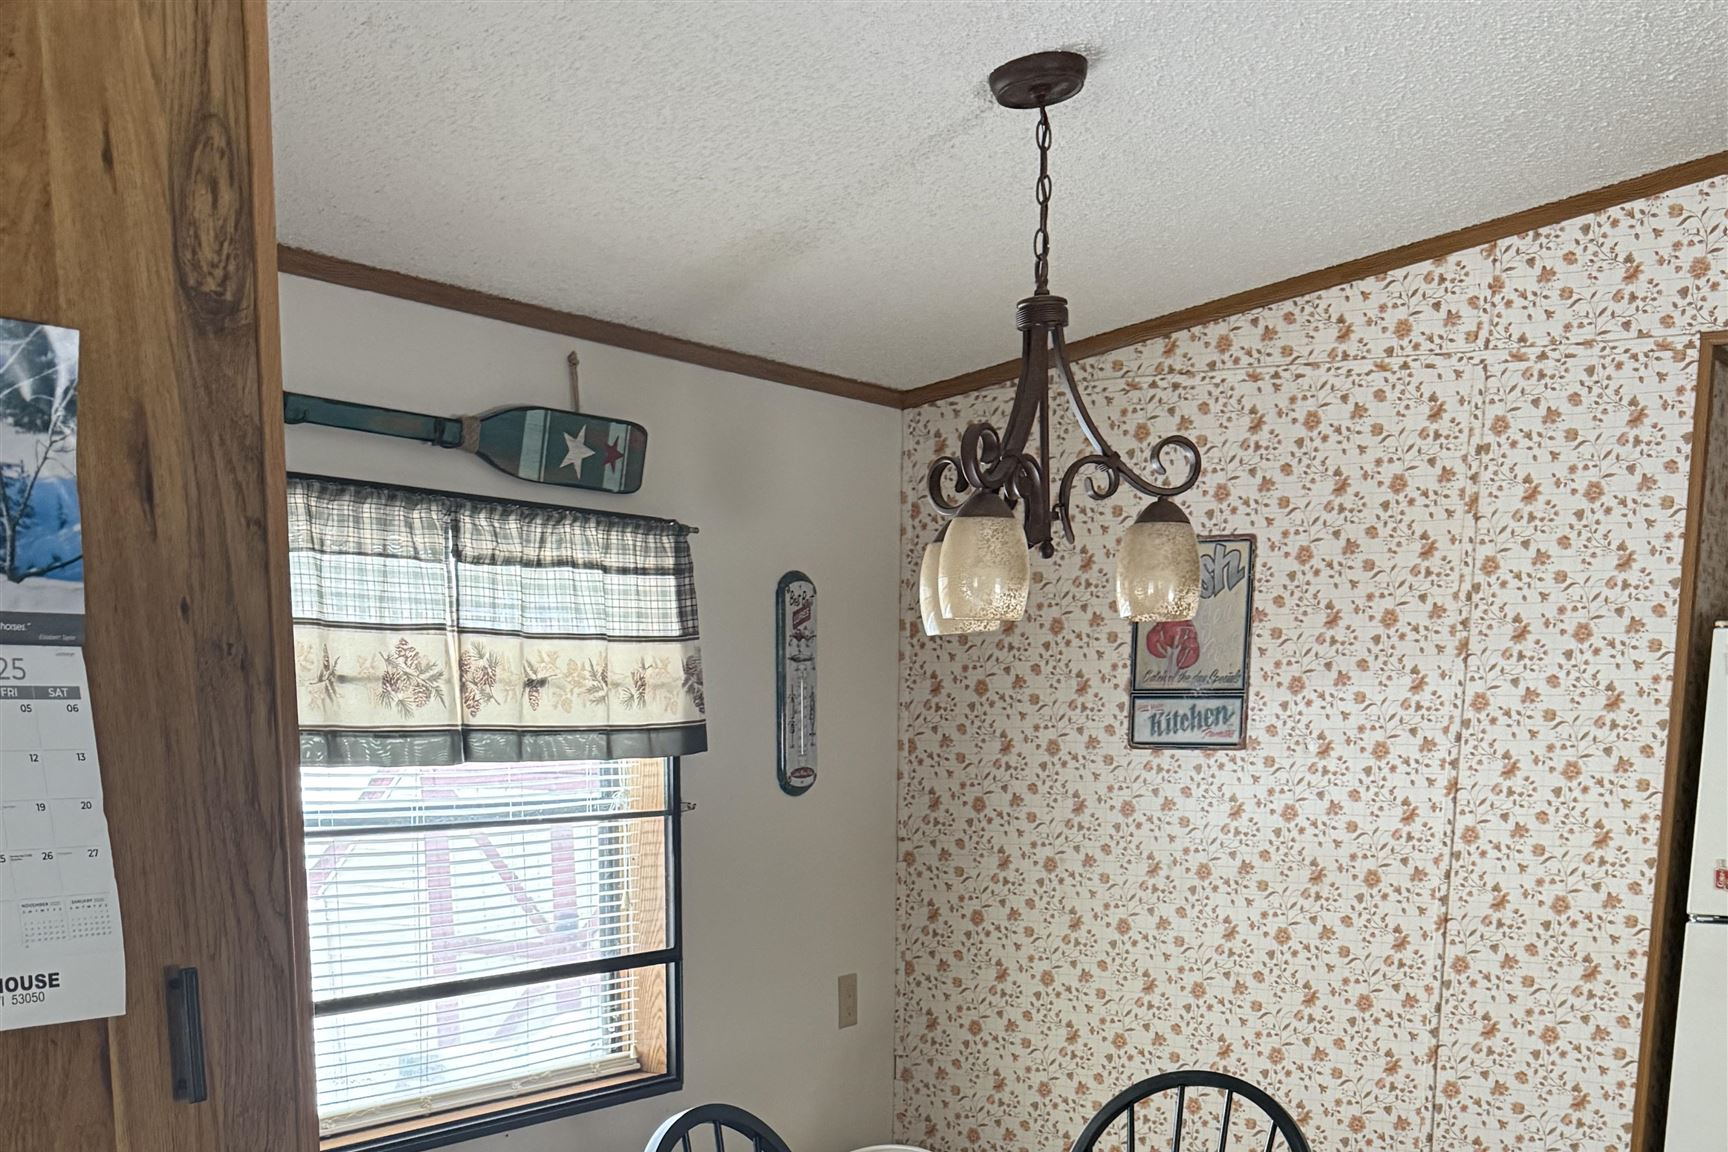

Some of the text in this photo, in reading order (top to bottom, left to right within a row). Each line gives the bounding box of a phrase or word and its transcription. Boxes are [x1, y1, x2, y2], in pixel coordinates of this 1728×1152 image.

[1200, 543, 1245, 599] sh
[0, 687, 68, 697] FRI SAT
[20, 704, 79, 713] 05 06
[1148, 703, 1235, 737] Kitchen
[29, 752, 86, 763] 12 13
[36, 801, 92, 812] 19 20
[0, 854, 6, 864] 5
[42, 851, 54, 861] 26
[87, 849, 99, 858] 27
[0, 972, 60, 993] OUSE
[11, 991, 46, 1006] 53050
